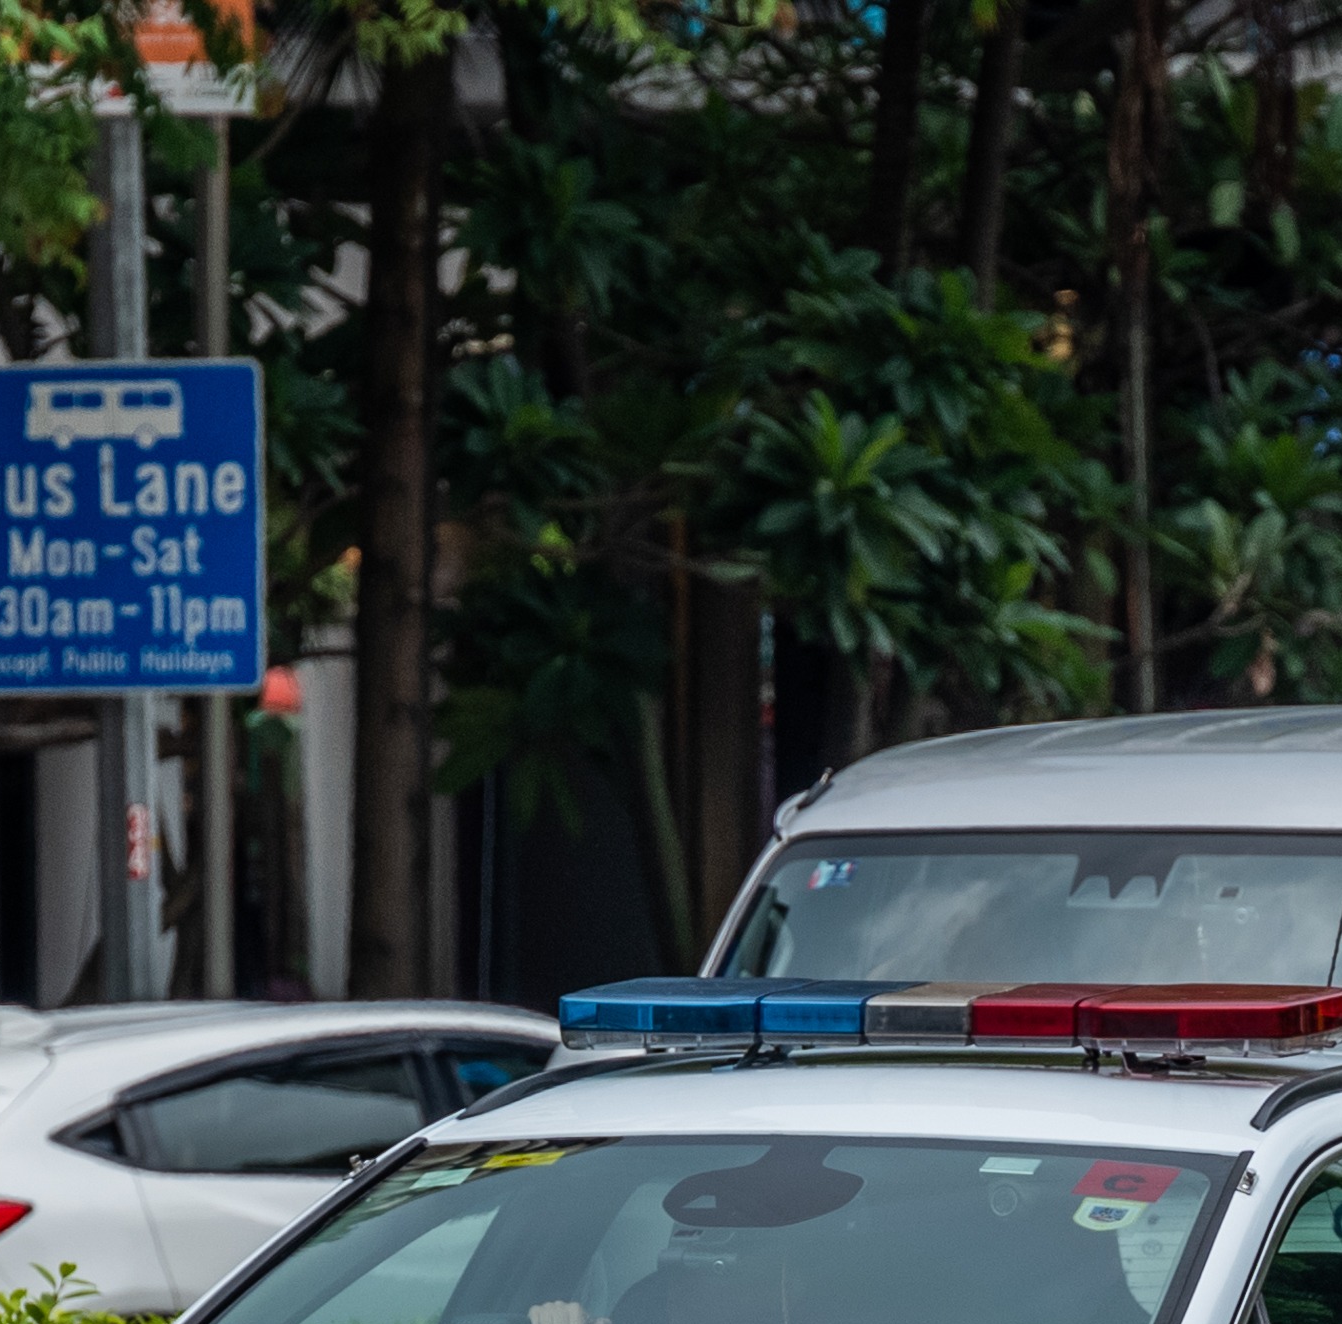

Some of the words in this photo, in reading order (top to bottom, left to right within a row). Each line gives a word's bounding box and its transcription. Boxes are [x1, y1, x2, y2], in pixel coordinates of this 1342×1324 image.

[99, 443, 246, 517] Lane
[61, 646, 129, 674] Public
[139, 644, 235, 674] Holidays
